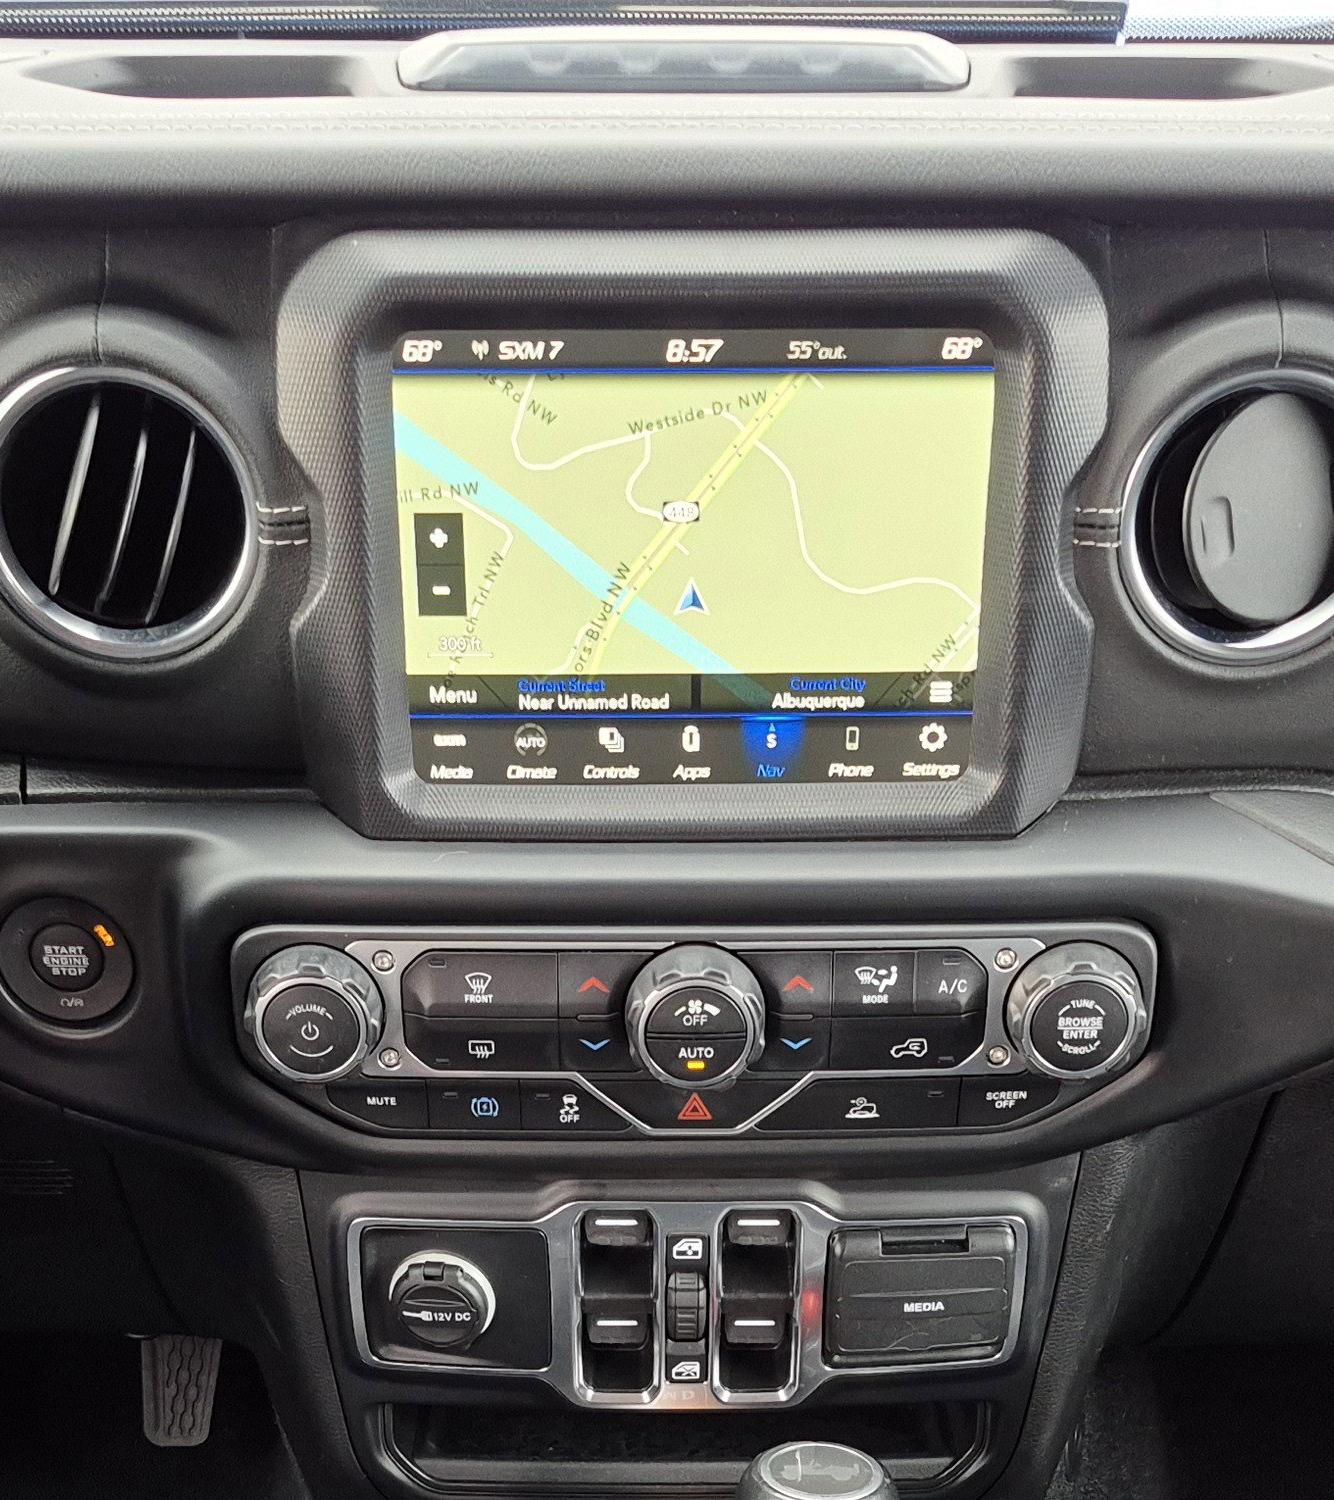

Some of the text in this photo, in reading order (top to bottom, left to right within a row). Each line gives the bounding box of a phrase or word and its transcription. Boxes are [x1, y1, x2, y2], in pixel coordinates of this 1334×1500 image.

[402, 339, 443, 363] 68°
[498, 341, 565, 360] SXM 7
[666, 339, 724, 363] 8:57
[941, 336, 984, 360] 68°
[527, 399, 559, 426] NW
[627, 389, 769, 436] Westside Dr NW
[421, 486, 443, 501] Rd
[450, 480, 480, 497] NW
[472, 586, 491, 607] Trl
[484, 550, 505, 583] NW
[585, 600, 613, 642] Blvd
[606, 561, 631, 598] NW
[438, 636, 483, 652] 300 ft
[931, 633, 956, 663] NW
[518, 679, 606, 693] Current Street
[789, 677, 867, 693] Current City
[429, 685, 479, 704] Menu
[518, 692, 671, 711] Near Unnamed Road
[771, 692, 866, 712] Albuquerque
[516, 736, 547, 750] AUTO
[765, 733, 777, 750] S
[430, 764, 474, 780] Media
[506, 764, 558, 780] Climate
[582, 764, 640, 780] Controls
[672, 763, 712, 781] Apps
[756, 763, 786, 779] Nav
[827, 762, 874, 778] Phone
[902, 762, 961, 780] Settings
[43, 944, 85, 955] START
[42, 956, 90, 966] ENGINE
[51, 966, 87, 977] STOP
[938, 978, 968, 995] A/C
[464, 994, 494, 1004] FRONT
[862, 994, 889, 1004] MODE
[1070, 998, 1096, 1010] TUNE
[288, 1003, 328, 1017] VOLUME
[682, 1014, 708, 1027] OFF
[1058, 1016, 1104, 1027] BROWSE
[1062, 1029, 1099, 1040] ENTER
[678, 1046, 715, 1059] AUTO
[1061, 1043, 1097, 1055] SCROLL
[366, 1096, 397, 1106] MUTE
[985, 1090, 1028, 1101] SCREEN
[994, 1099, 1017, 1109] OFF
[559, 1114, 581, 1124] OFF
[903, 1301, 946, 1313] MEDIA
[433, 1311, 472, 1322] 12V DC
